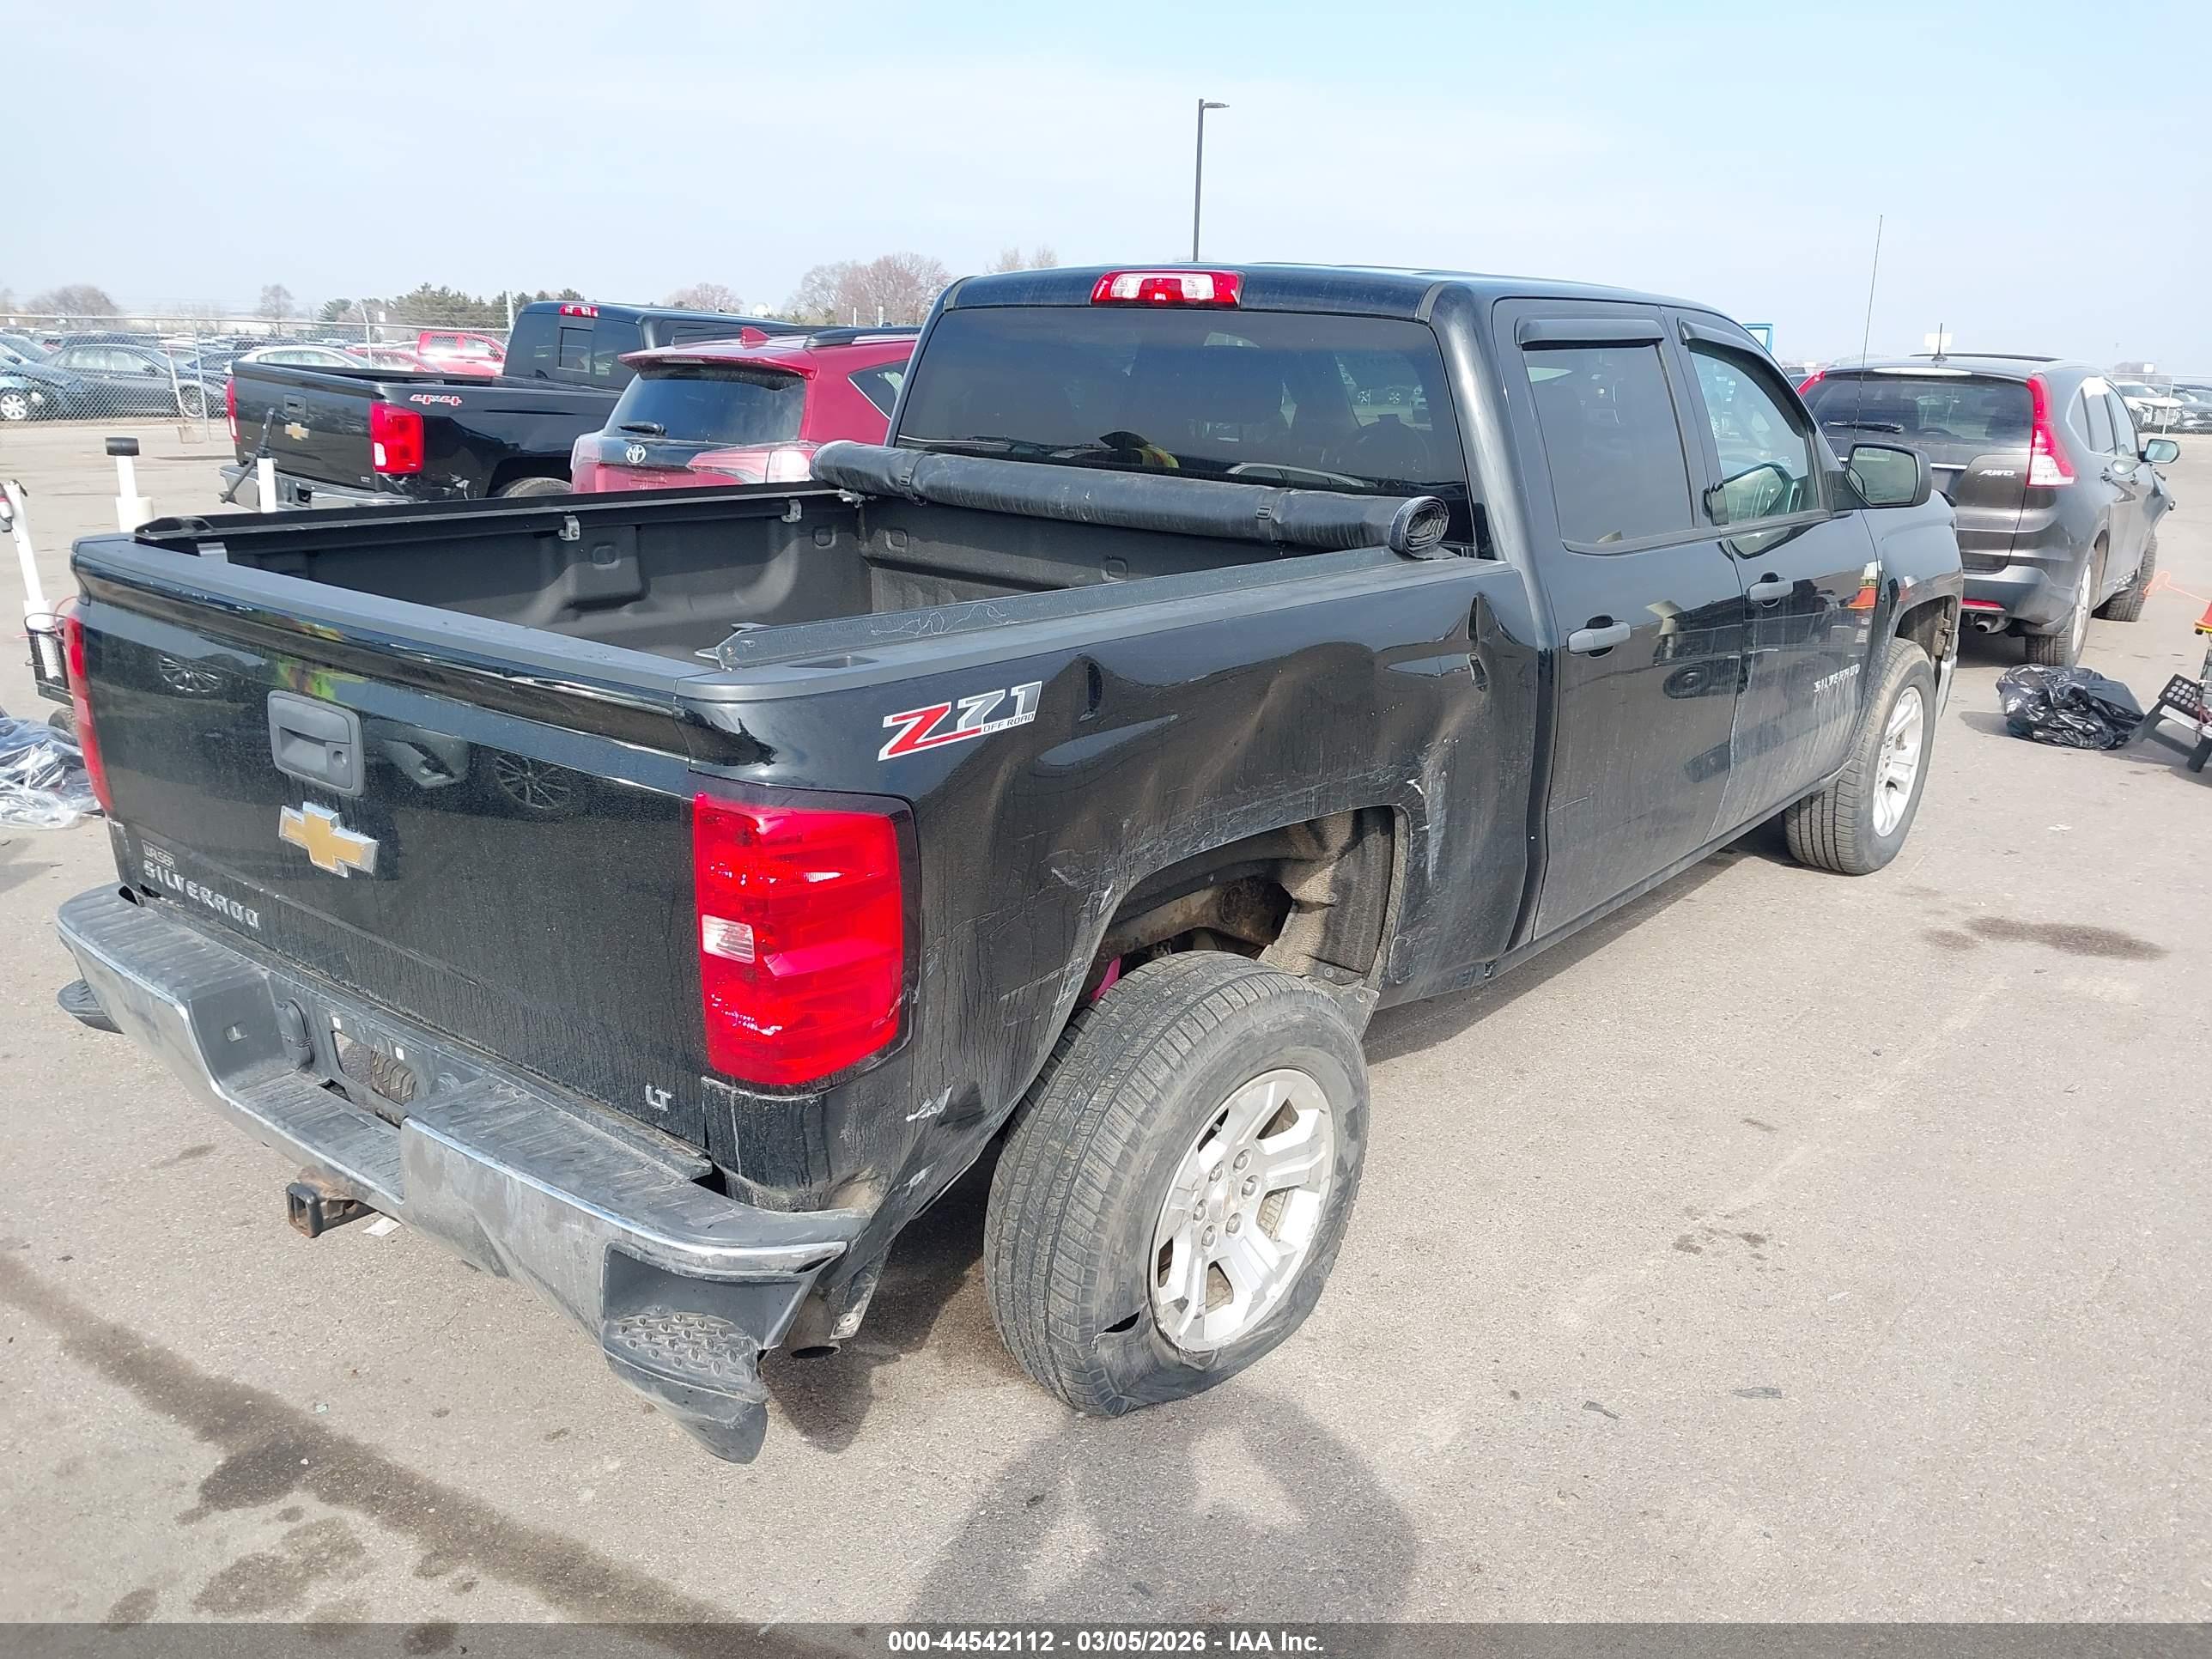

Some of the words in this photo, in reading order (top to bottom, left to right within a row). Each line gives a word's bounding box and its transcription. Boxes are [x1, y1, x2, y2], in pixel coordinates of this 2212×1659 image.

[1814, 663, 1861, 693] SILVERADO
[878, 680, 1042, 762] Z71
[983, 721, 1004, 732] OFF
[1006, 714, 1034, 726] ROAD
[143, 860, 259, 930] SILVERADO
[646, 1085, 672, 1111] LT
